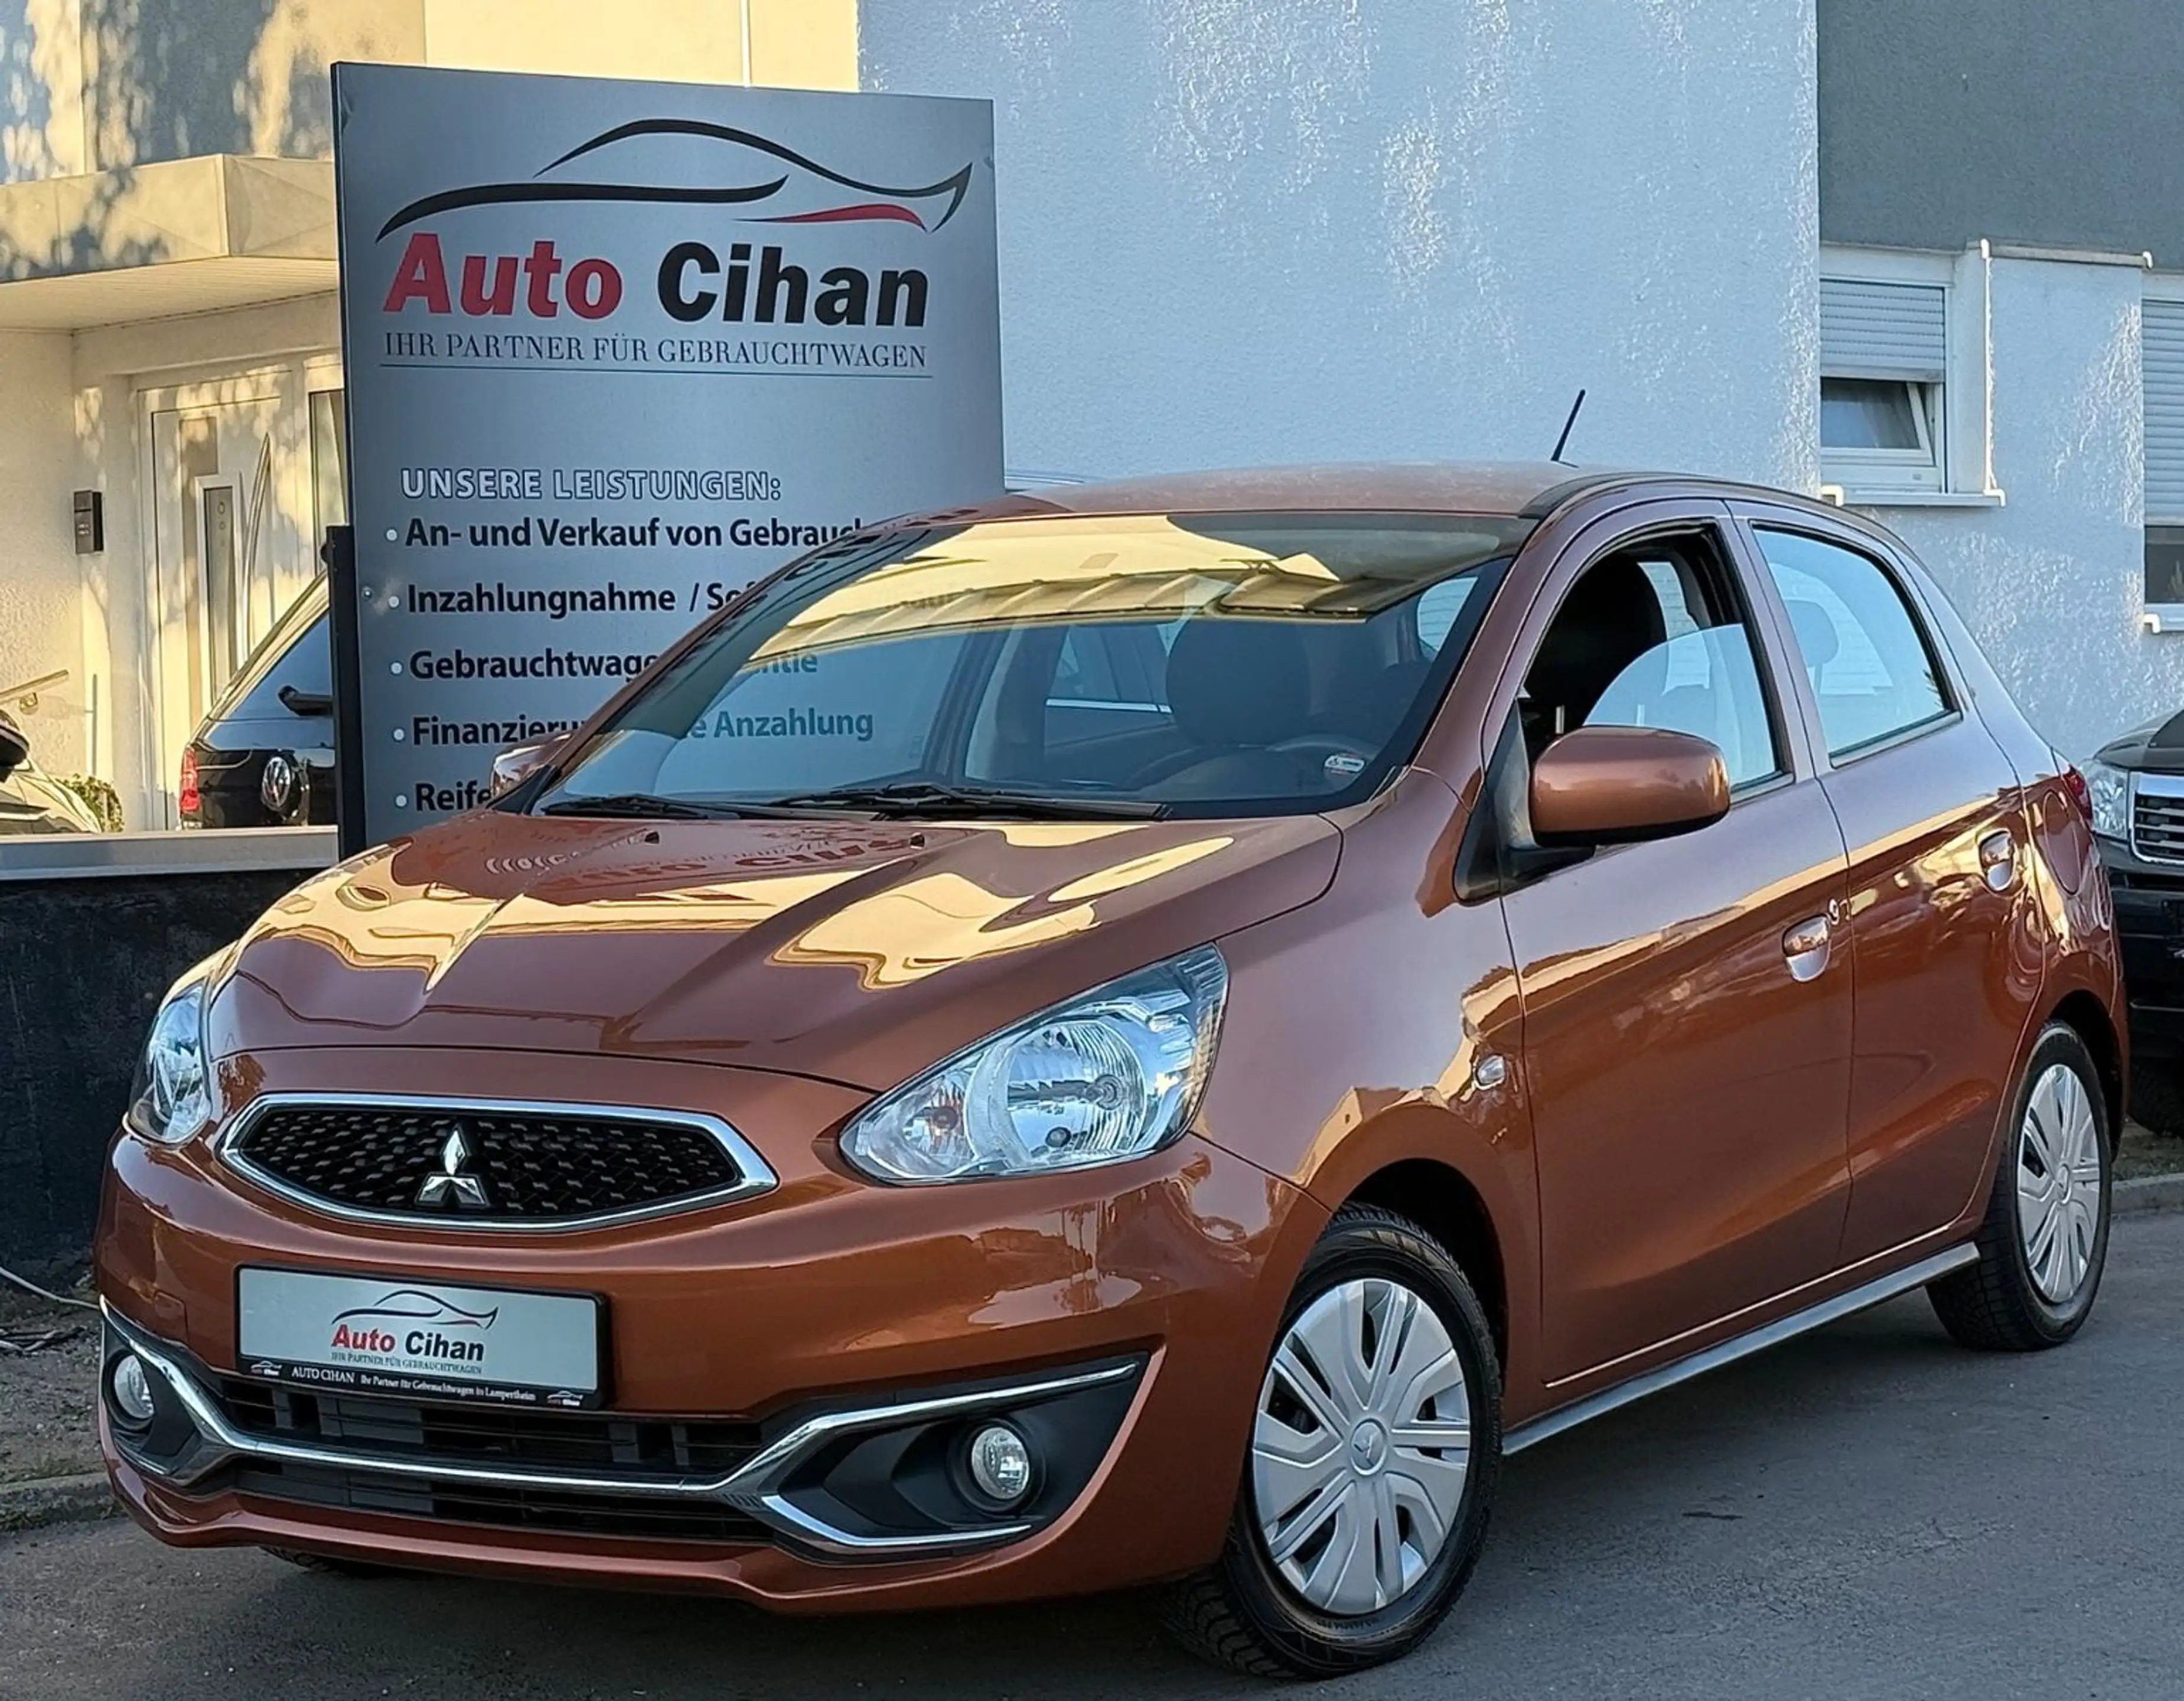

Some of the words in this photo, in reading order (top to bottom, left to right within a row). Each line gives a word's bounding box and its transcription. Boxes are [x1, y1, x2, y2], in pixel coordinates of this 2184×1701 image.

[383, 233, 623, 320] Auto
[657, 241, 930, 328] Cihan
[386, 332, 438, 358] IHR
[447, 333, 585, 362] PARTNER
[593, 332, 649, 363] FÜR
[657, 339, 927, 369] GEBRAUCHTWAGEN
[401, 468, 542, 498] UNSERE
[553, 469, 781, 501] LEISTUNGEN:
[405, 518, 461, 546] An-
[470, 517, 530, 546] und
[537, 517, 660, 546] Verkauf
[666, 524, 722, 546] von
[408, 582, 675, 620] Inzahlungnahme
[713, 707, 873, 741] Anzahlung
[331, 1324, 396, 1353] Auto
[405, 1331, 484, 1361] Cihan
[292, 1366, 320, 1380] AUTO
[320, 1369, 356, 1383] CIHAN
